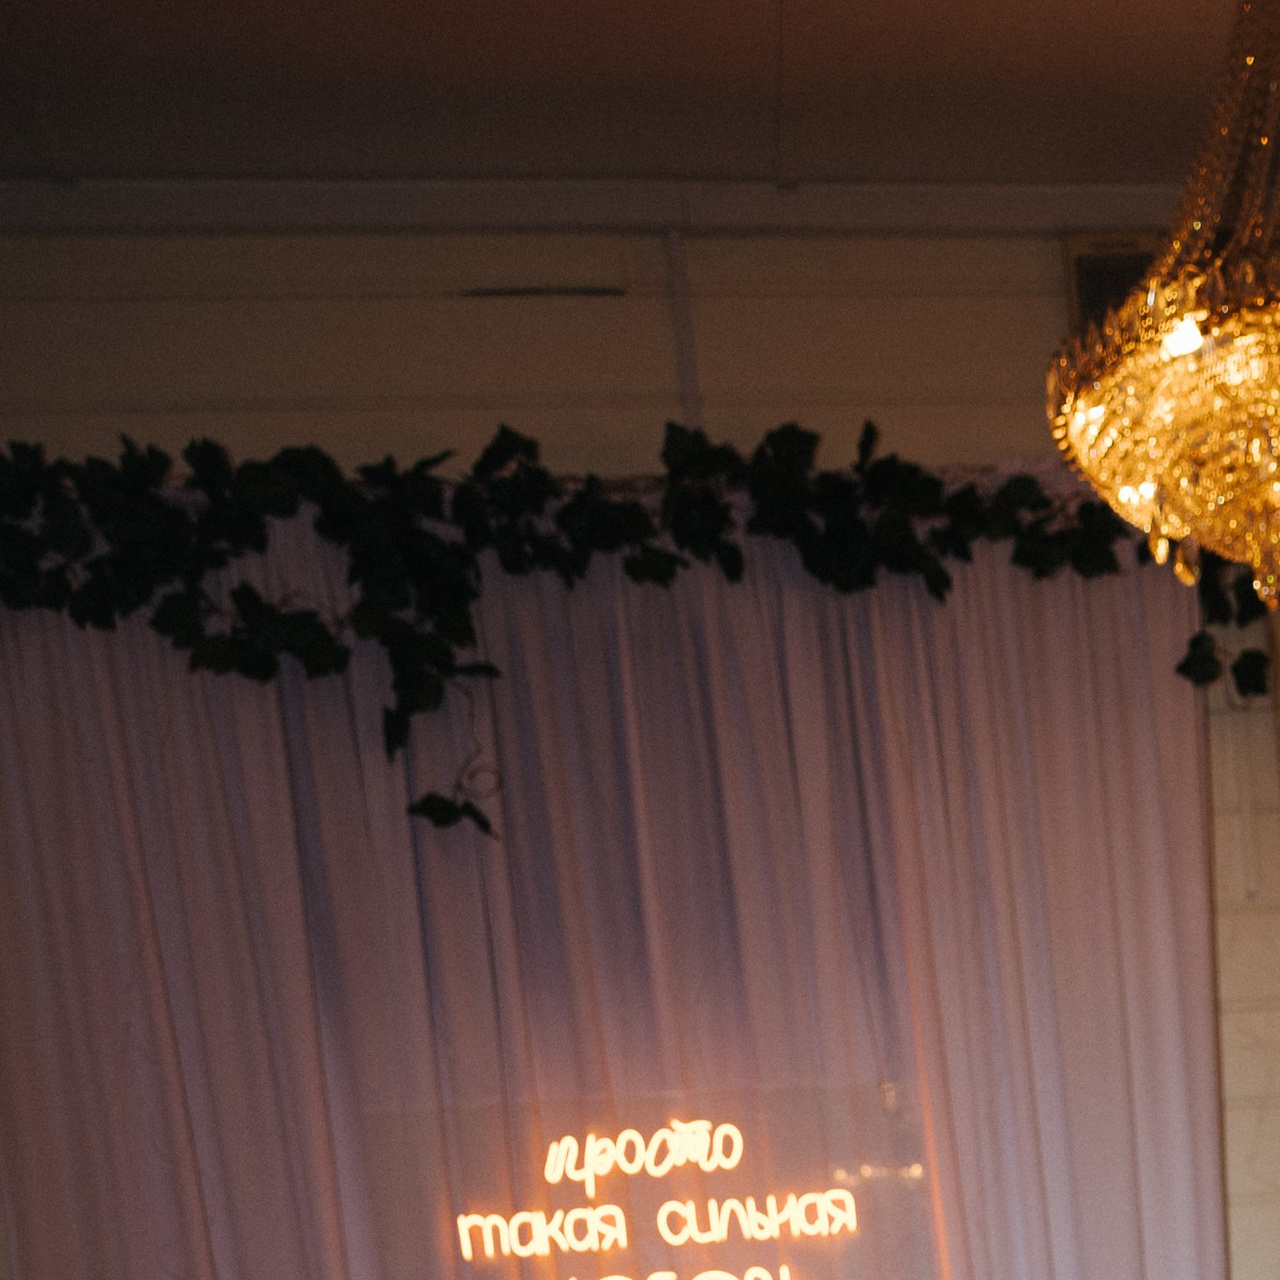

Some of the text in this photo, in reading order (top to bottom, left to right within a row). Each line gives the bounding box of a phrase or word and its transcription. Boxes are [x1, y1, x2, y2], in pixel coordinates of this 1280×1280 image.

[544, 1119, 744, 1198] просто
[457, 1188, 857, 1261] такая сильная
